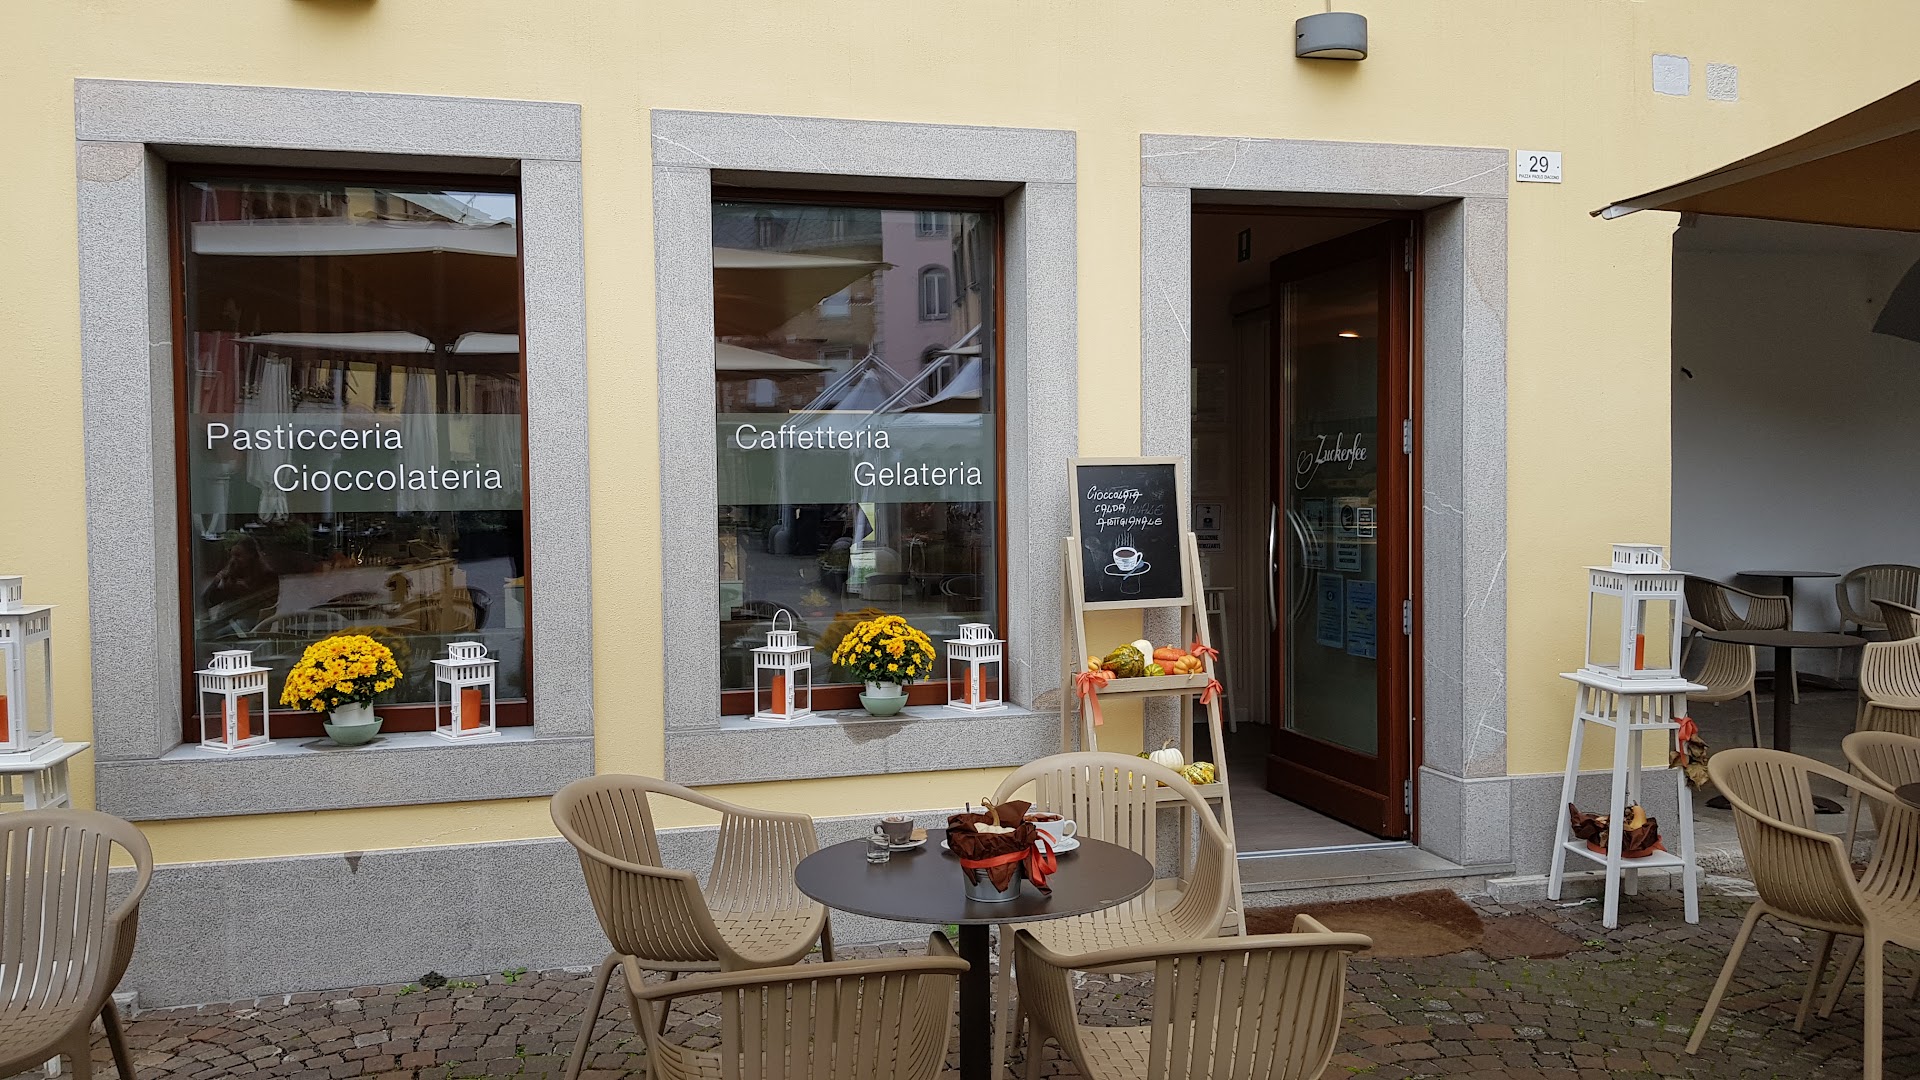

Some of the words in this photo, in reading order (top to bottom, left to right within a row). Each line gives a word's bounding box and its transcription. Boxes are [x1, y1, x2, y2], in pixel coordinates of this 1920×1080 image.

[1530, 156, 1548, 172] 29
[206, 422, 403, 450] Pasticceria
[735, 423, 891, 450] Caffetteria
[1295, 431, 1368, 490] Zuckerfee
[273, 463, 503, 492] Cioccolateria
[854, 461, 983, 487] Gelateria
[1094, 503, 1127, 517] CALDA
[1096, 516, 1163, 532] ARTIGIANALE
